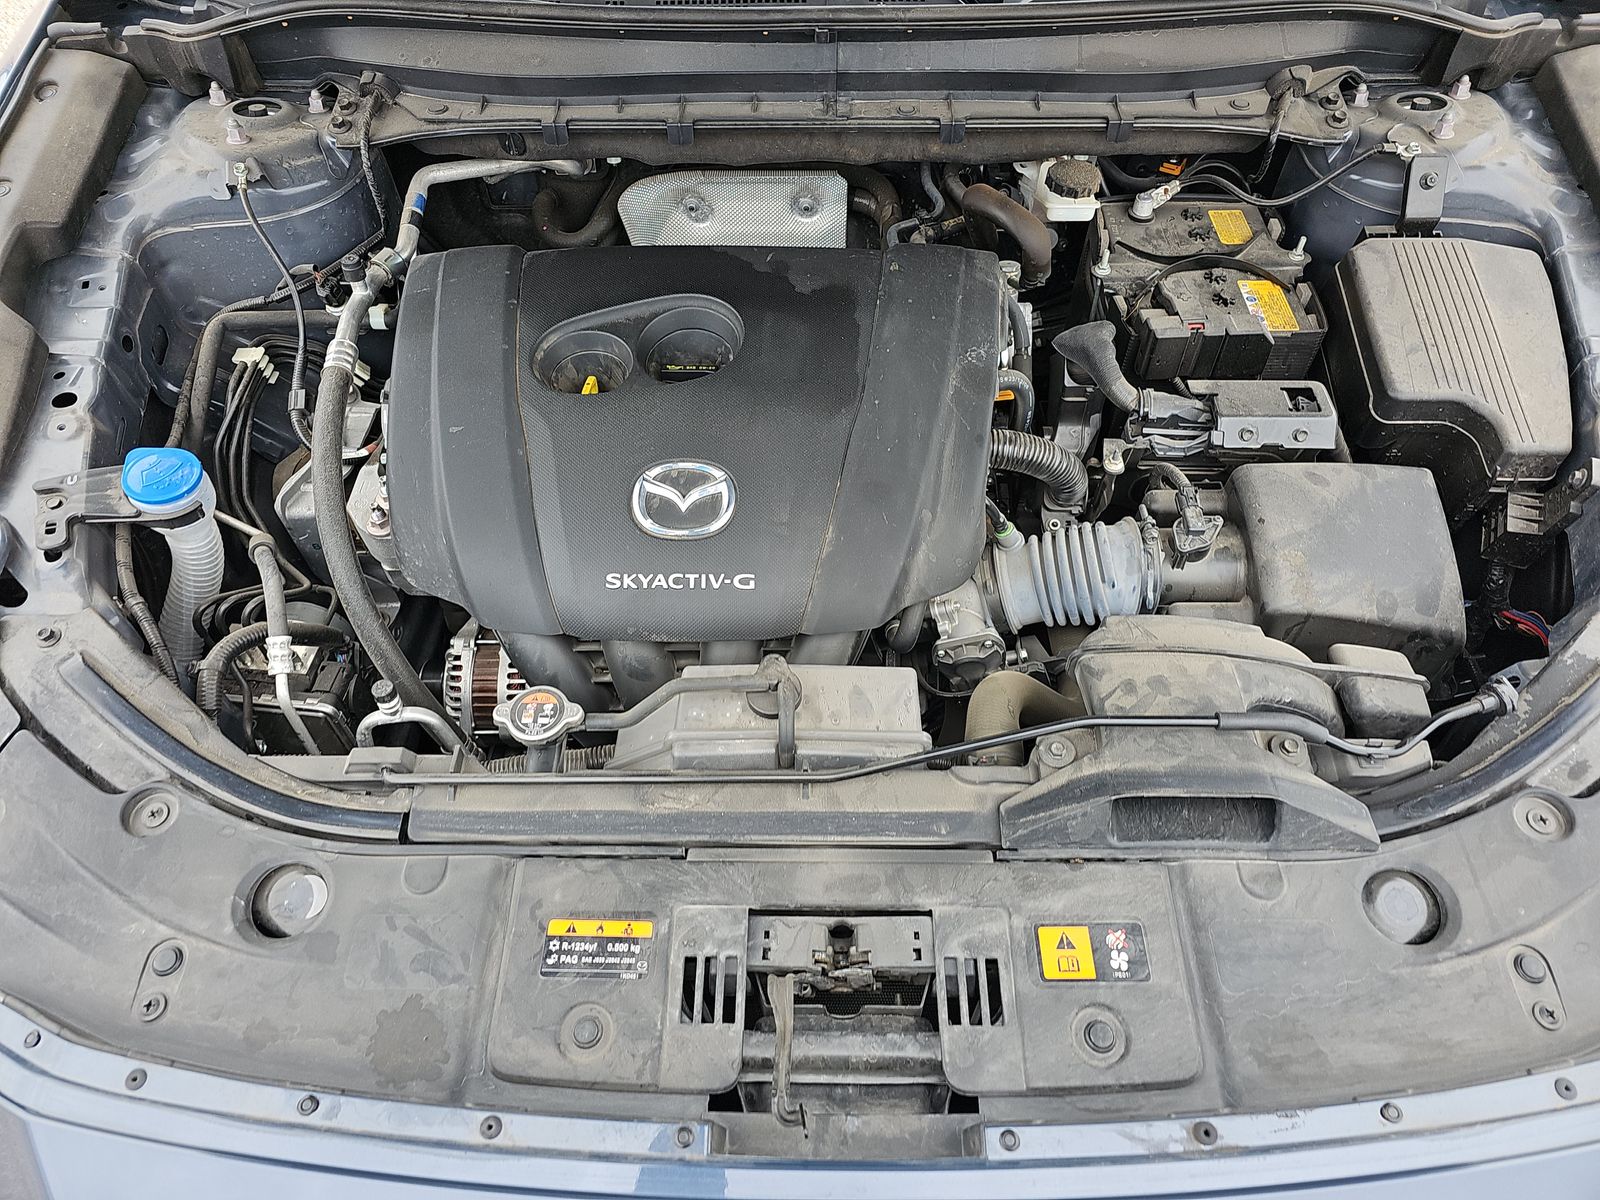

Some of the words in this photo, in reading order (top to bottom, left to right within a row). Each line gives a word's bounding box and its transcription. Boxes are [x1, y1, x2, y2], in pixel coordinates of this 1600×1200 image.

[605, 572, 756, 590] SKYACTIV-G
[561, 941, 598, 953] R-1234yf
[630, 943, 641, 954] kg
[560, 954, 579, 964] PAG
